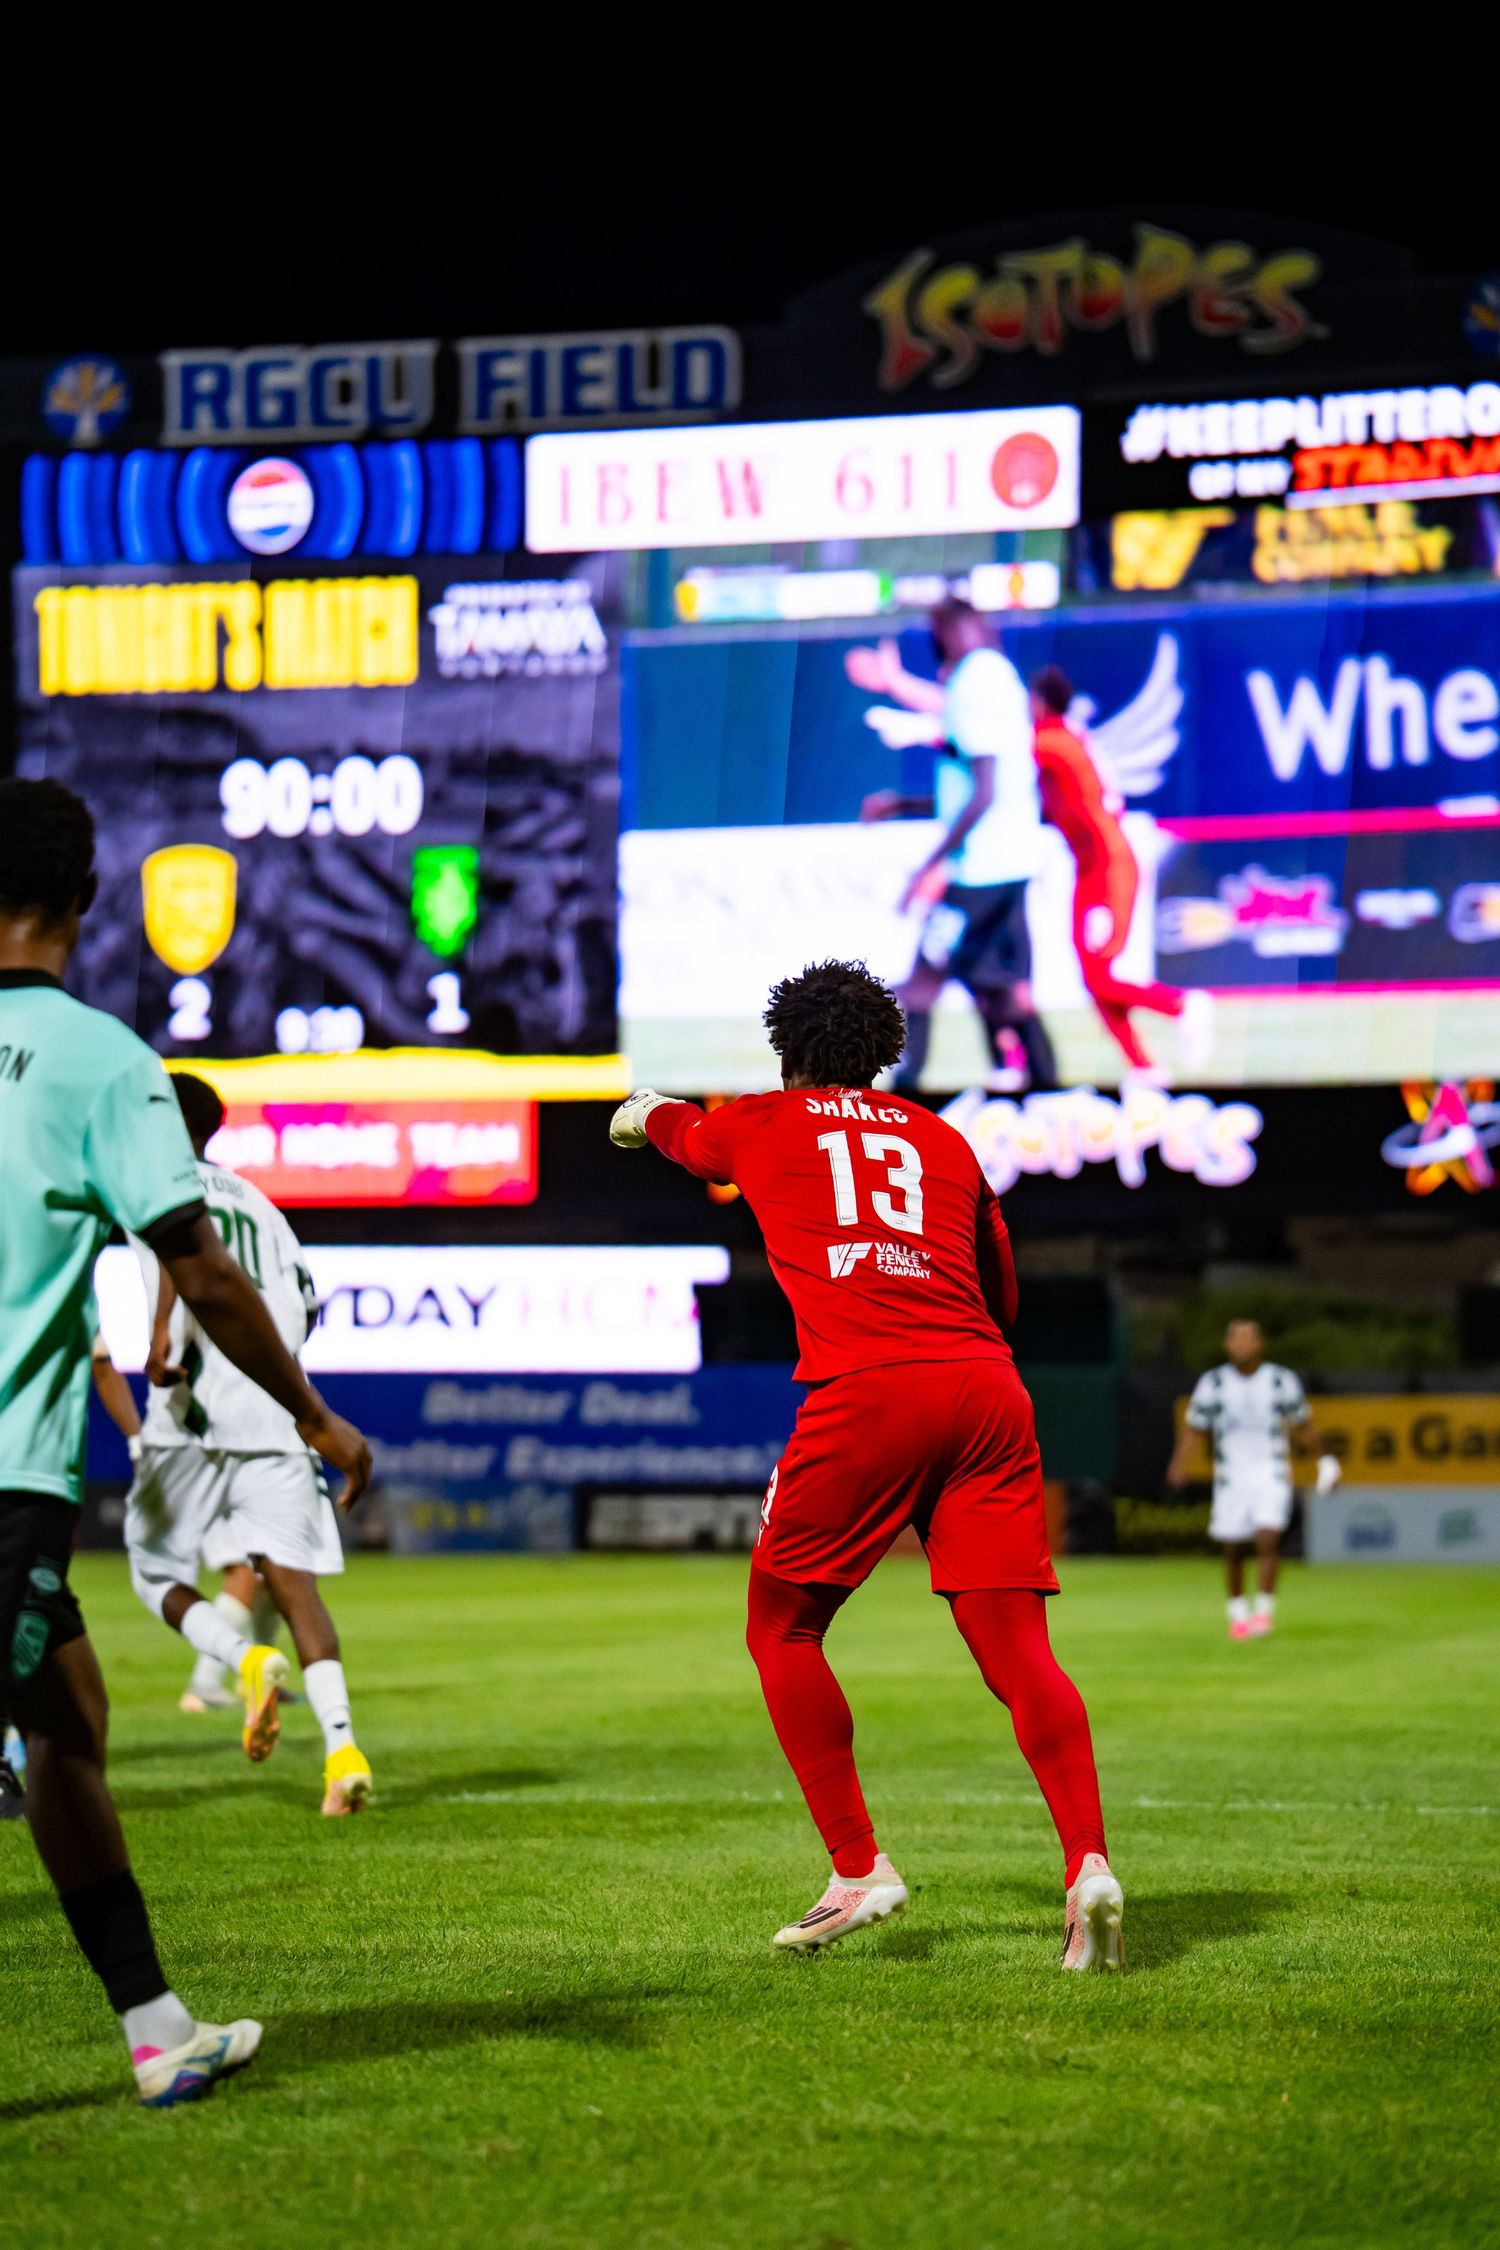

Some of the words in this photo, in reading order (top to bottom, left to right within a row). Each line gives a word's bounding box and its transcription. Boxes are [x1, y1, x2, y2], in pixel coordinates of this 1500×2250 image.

[463, 332, 737, 427] FIELD
[557, 455, 776, 527] IBEW
[834, 447, 960, 513] 611
[219, 755, 424, 840] 90:00
[168, 977, 213, 1041] 2
[427, 971, 471, 1034] 1
[817, 1130, 924, 1235] 13
[874, 1242, 931, 1262] VALLEY
[876, 1253, 922, 1269] FENCE
[877, 1265, 931, 1280] COMPANY
[422, 1381, 570, 1425] Better
[1410, 1414, 1500, 1463] Ga
